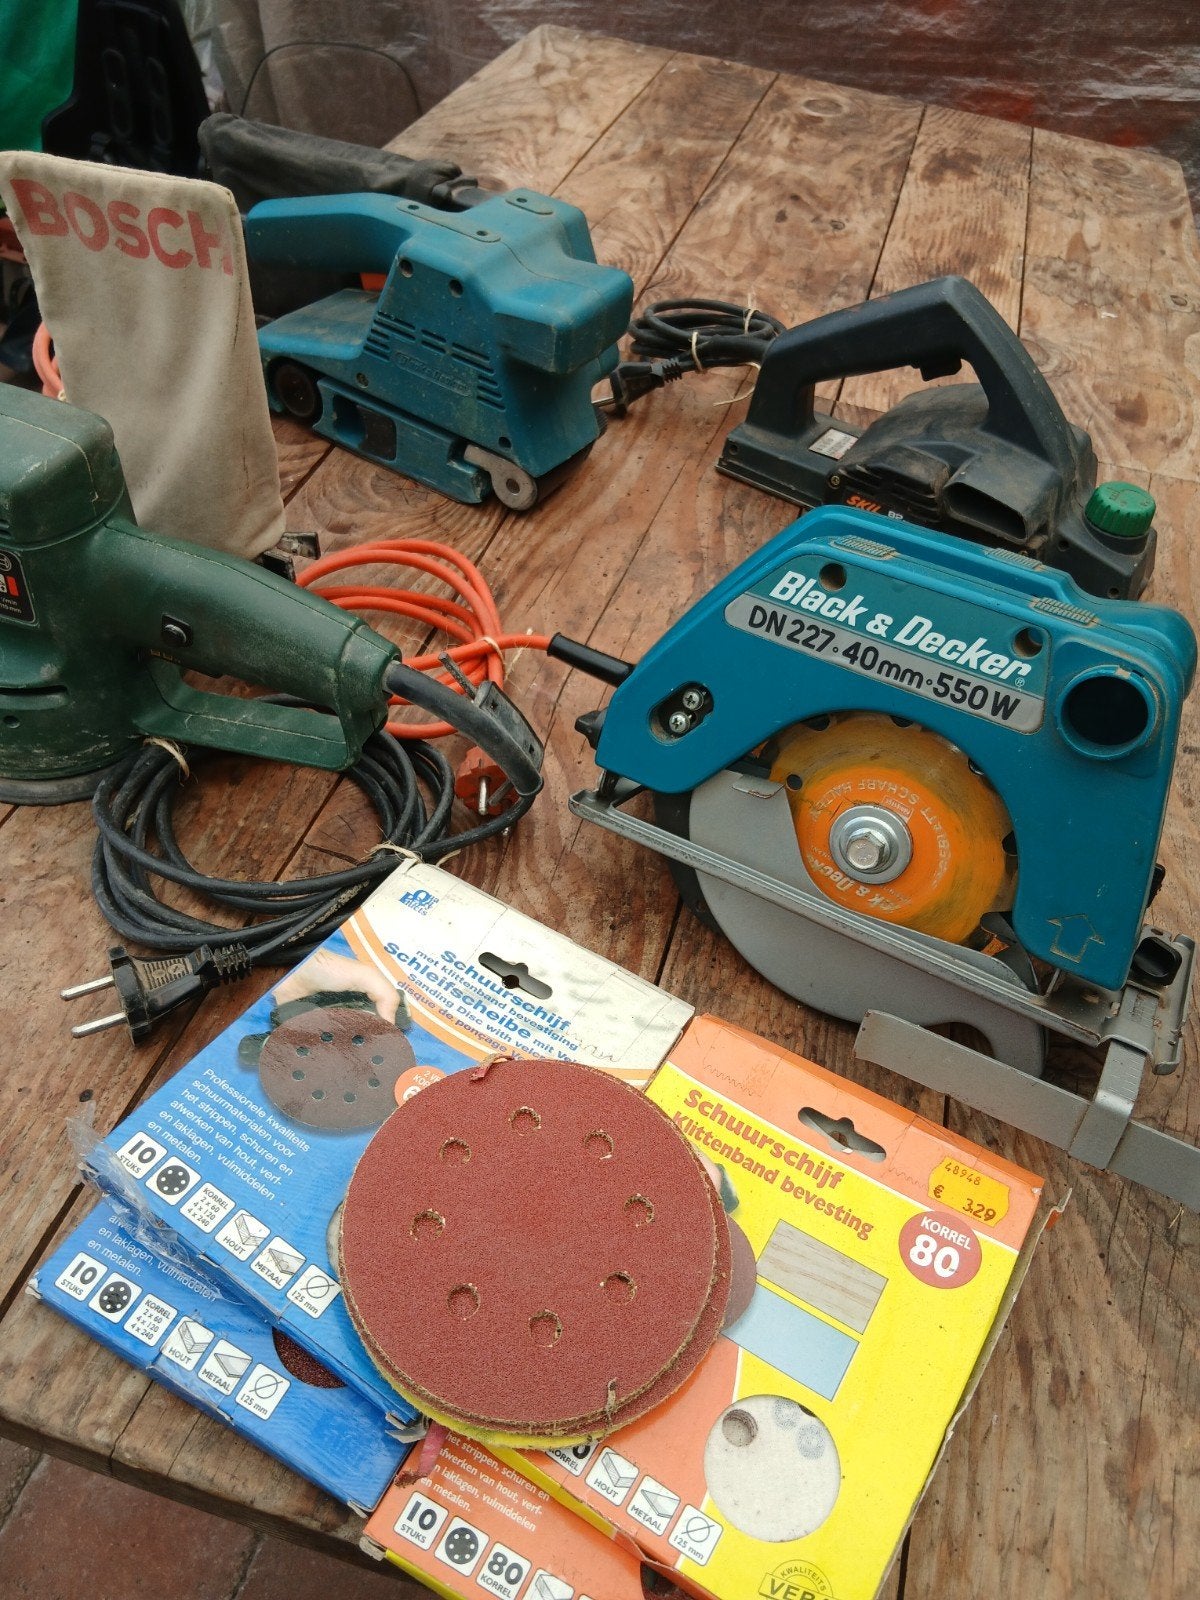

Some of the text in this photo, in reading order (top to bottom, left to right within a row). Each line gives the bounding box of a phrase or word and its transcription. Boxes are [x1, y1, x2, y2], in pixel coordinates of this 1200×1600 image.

[10, 178, 234, 277] BOSCH
[846, 495, 882, 513] SKIL
[769, 570, 1032, 681] Black & Decker
[383, 942, 532, 1039] Schleifscheibe
[532, 1038, 555, 1054] mit
[416, 950, 440, 968] met
[441, 965, 508, 1010] klittenband
[508, 1007, 579, 1051] bevestiging
[441, 950, 572, 1031] Schuurschijf
[396, 980, 436, 1009] disque
[438, 1007, 454, 1020] de
[454, 1019, 508, 1052] ponçage
[407, 973, 455, 1009] Sanding
[456, 1005, 483, 1025] Disc
[486, 1024, 512, 1043] with
[192, 1079, 296, 1159] schuurmaterialen voor
[203, 1068, 311, 1154] Professionele kwaliteits
[148, 1120, 201, 1165] en metalen.
[170, 1098, 283, 1186] afwerken van hout, verf-
[181, 1088, 294, 1177] het strippen, schuren en
[684, 1089, 846, 1190] Schuurschijf
[119, 1155, 142, 1174] STUKS
[128, 1139, 157, 1164] 10
[159, 1109, 276, 1201] en laklagen, vulmiddelen
[672, 1110, 875, 1241] Klittenband bevesting
[944, 1162, 981, 1186] 48948
[203, 1187, 229, 1210] KORREL
[933, 1184, 945, 1199] €
[197, 1215, 210, 1227] 240
[203, 1209, 216, 1221] 120
[210, 1205, 220, 1213] 60
[223, 1235, 246, 1256] HOUT
[919, 1215, 973, 1251] KORREL
[87, 1239, 142, 1277] en metalen.
[98, 1226, 217, 1303] en laklagen, vulmiddelen
[909, 1233, 960, 1278] 80
[70, 1260, 98, 1285] 10
[254, 1260, 283, 1286] METAAL
[60, 1278, 84, 1296] STUKS
[145, 1299, 171, 1320] KORREL
[291, 1289, 319, 1315] 125 mm
[147, 1322, 159, 1333] 120
[154, 1315, 162, 1324] 60
[141, 1328, 154, 1340] 240
[169, 1347, 192, 1365] HOUT
[201, 1367, 231, 1392] METAAL
[240, 1393, 269, 1416] 125 mm
[445, 1431, 550, 1502] het strippen, schuren en
[420, 1476, 471, 1512] en metalen.
[441, 1466, 480, 1499] laklagen,
[482, 1493, 537, 1532] vulmiddelen
[480, 1471, 495, 1487] van
[496, 1481, 519, 1504] hout,
[521, 1498, 543, 1515] verf-
[593, 1476, 619, 1499] HOUT
[407, 1500, 438, 1531] 10
[630, 1504, 663, 1532] METAAL
[400, 1523, 427, 1544] STUKS
[673, 1534, 705, 1561] 125 mm
[487, 1551, 523, 1586] 80
[780, 1565, 827, 1592] KWALITEITS
[480, 1573, 512, 1599] KORREL
